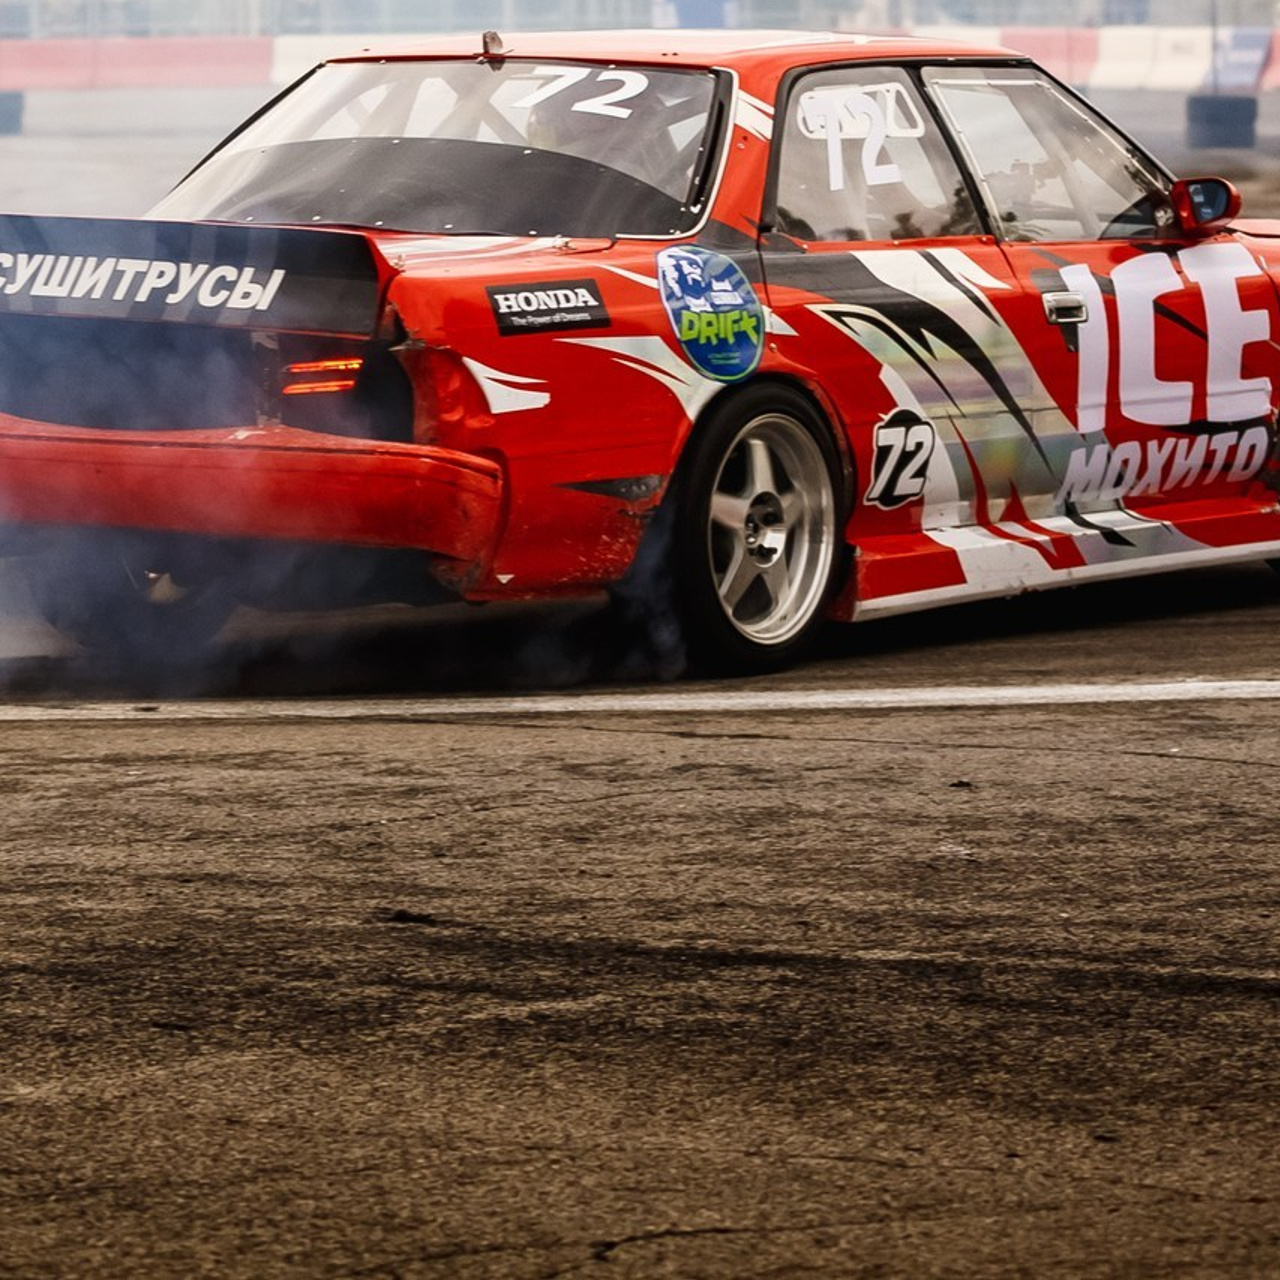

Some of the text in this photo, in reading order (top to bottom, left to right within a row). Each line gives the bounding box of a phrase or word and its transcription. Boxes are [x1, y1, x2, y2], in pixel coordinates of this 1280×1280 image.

[510, 66, 649, 119] 72
[800, 92, 903, 191] 72
[493, 288, 599, 313] HONDA
[1058, 242, 1272, 434] ICE
[868, 424, 933, 499] 72
[1053, 426, 1269, 503] МОХИТО
